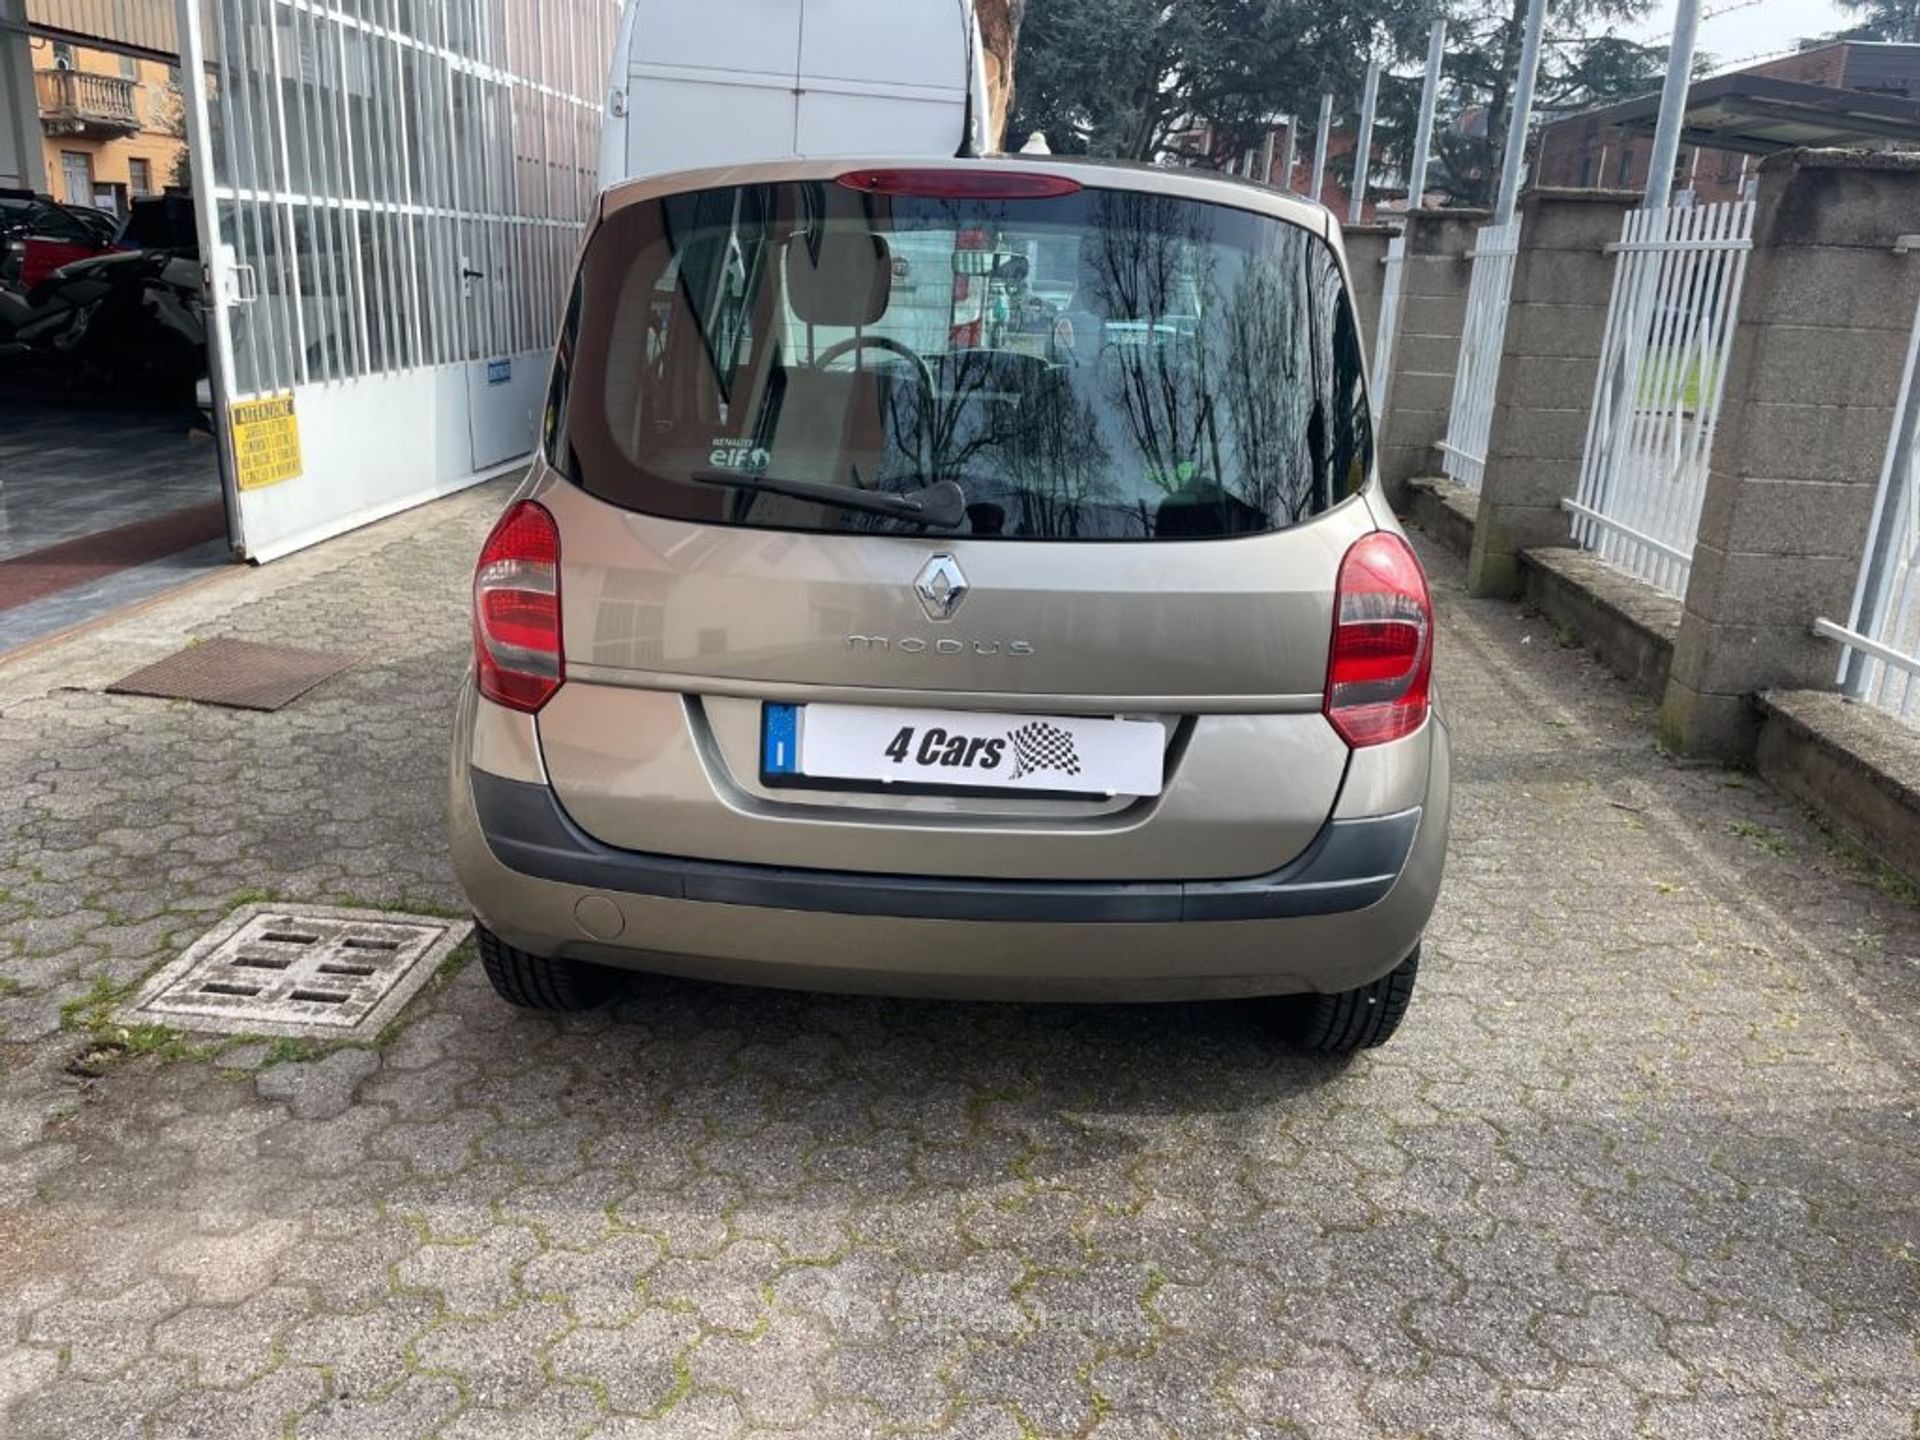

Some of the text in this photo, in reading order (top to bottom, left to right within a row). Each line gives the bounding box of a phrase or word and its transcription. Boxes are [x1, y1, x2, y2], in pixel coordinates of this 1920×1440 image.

[709, 448, 749, 467] elf
[884, 726, 1006, 769] 4 Cars
